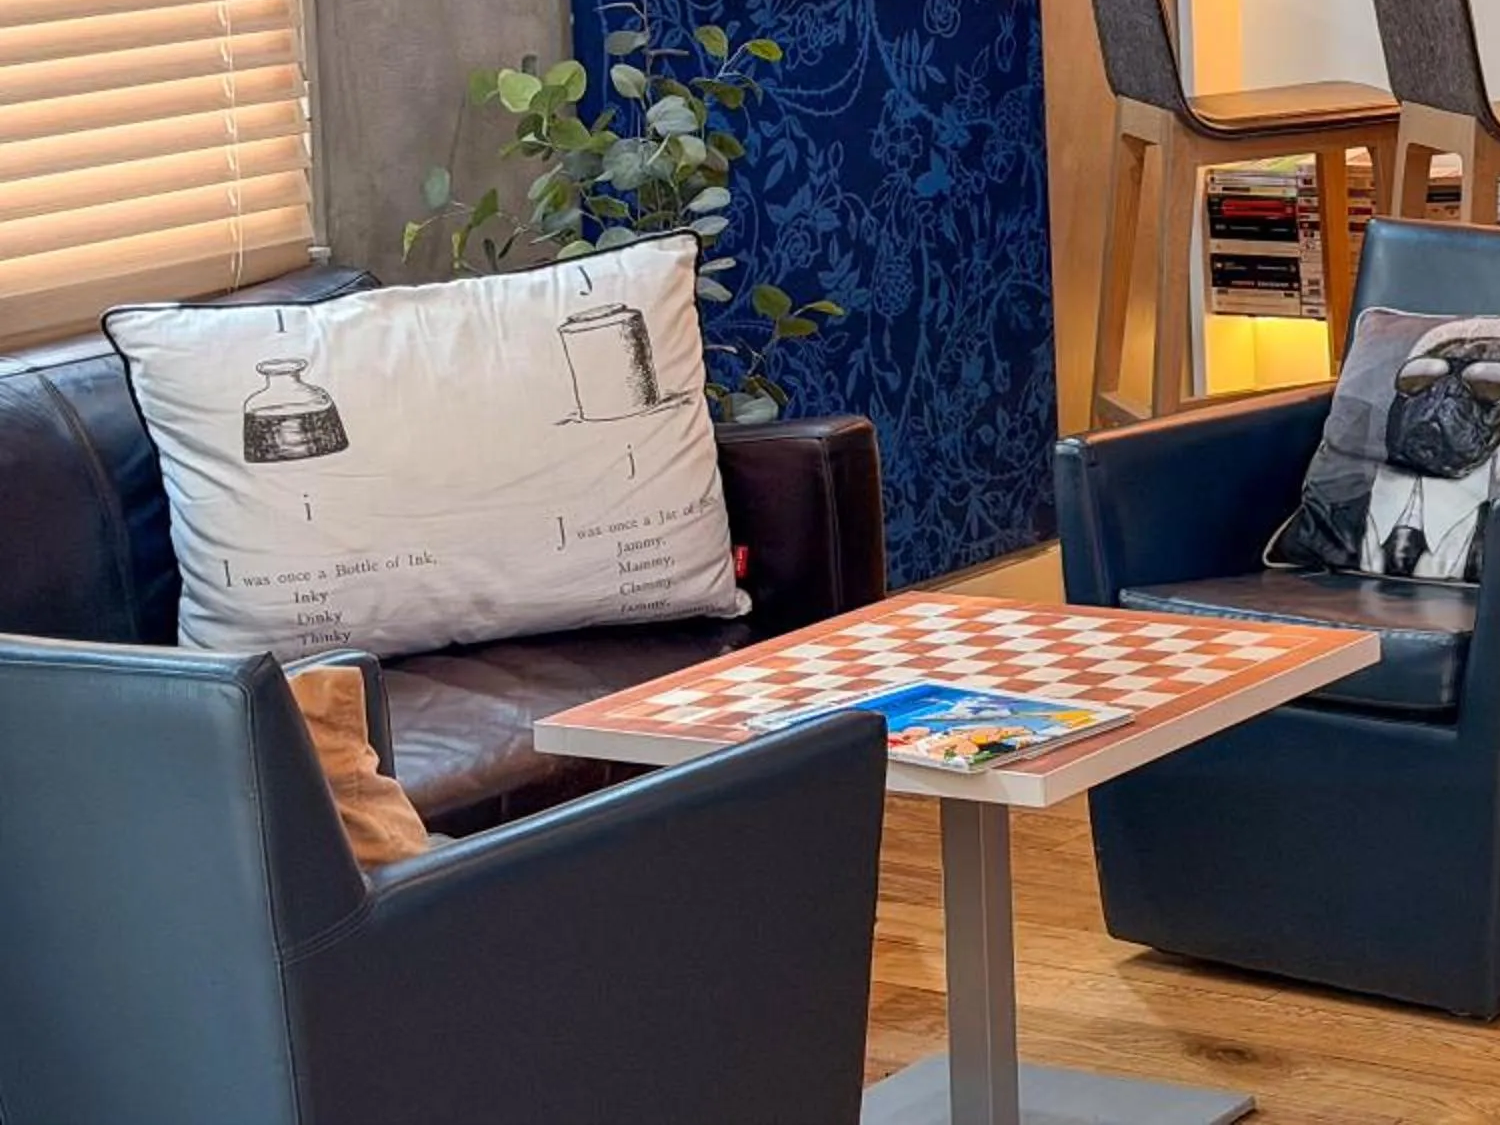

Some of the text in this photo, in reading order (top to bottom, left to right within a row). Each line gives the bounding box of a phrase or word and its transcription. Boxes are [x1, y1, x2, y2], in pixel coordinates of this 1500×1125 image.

[303, 493, 313, 521] i
[243, 575, 270, 587] was
[277, 572, 311, 584] once
[318, 569, 327, 579] a
[335, 559, 378, 578] Bottle
[385, 556, 399, 570] of
[293, 589, 329, 604] Inky
[297, 610, 343, 626] Dinky
[300, 631, 351, 646] Thinky
